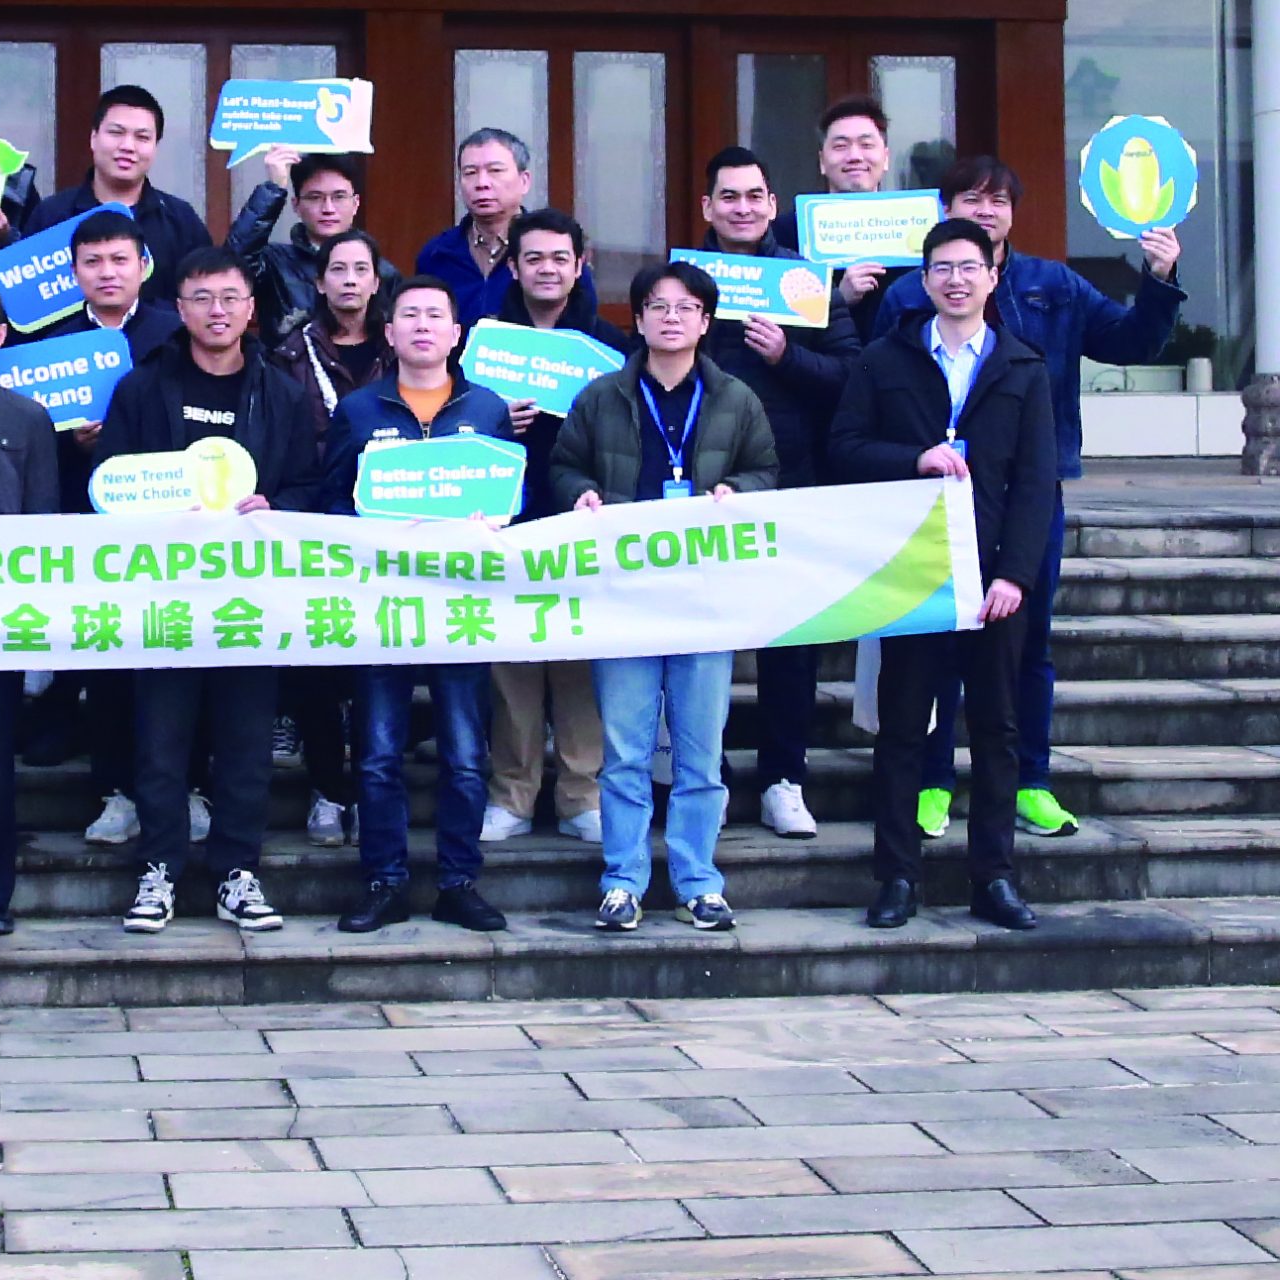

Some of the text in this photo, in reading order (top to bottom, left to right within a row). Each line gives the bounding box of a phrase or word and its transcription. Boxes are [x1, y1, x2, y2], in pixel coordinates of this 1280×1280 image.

[818, 216, 928, 229] Natural Choice for
[820, 229, 903, 244] Vege Capsule
[93, 350, 120, 370] to
[477, 345, 528, 367] Better
[530, 356, 584, 378] Choice
[474, 362, 558, 390] Better Life
[102, 466, 184, 485] New Trend
[370, 463, 515, 482] Better Choice for
[104, 486, 192, 503] New Choice
[371, 482, 462, 500] Better Life
[521, 540, 601, 581] WE
[615, 521, 778, 570] COME!
